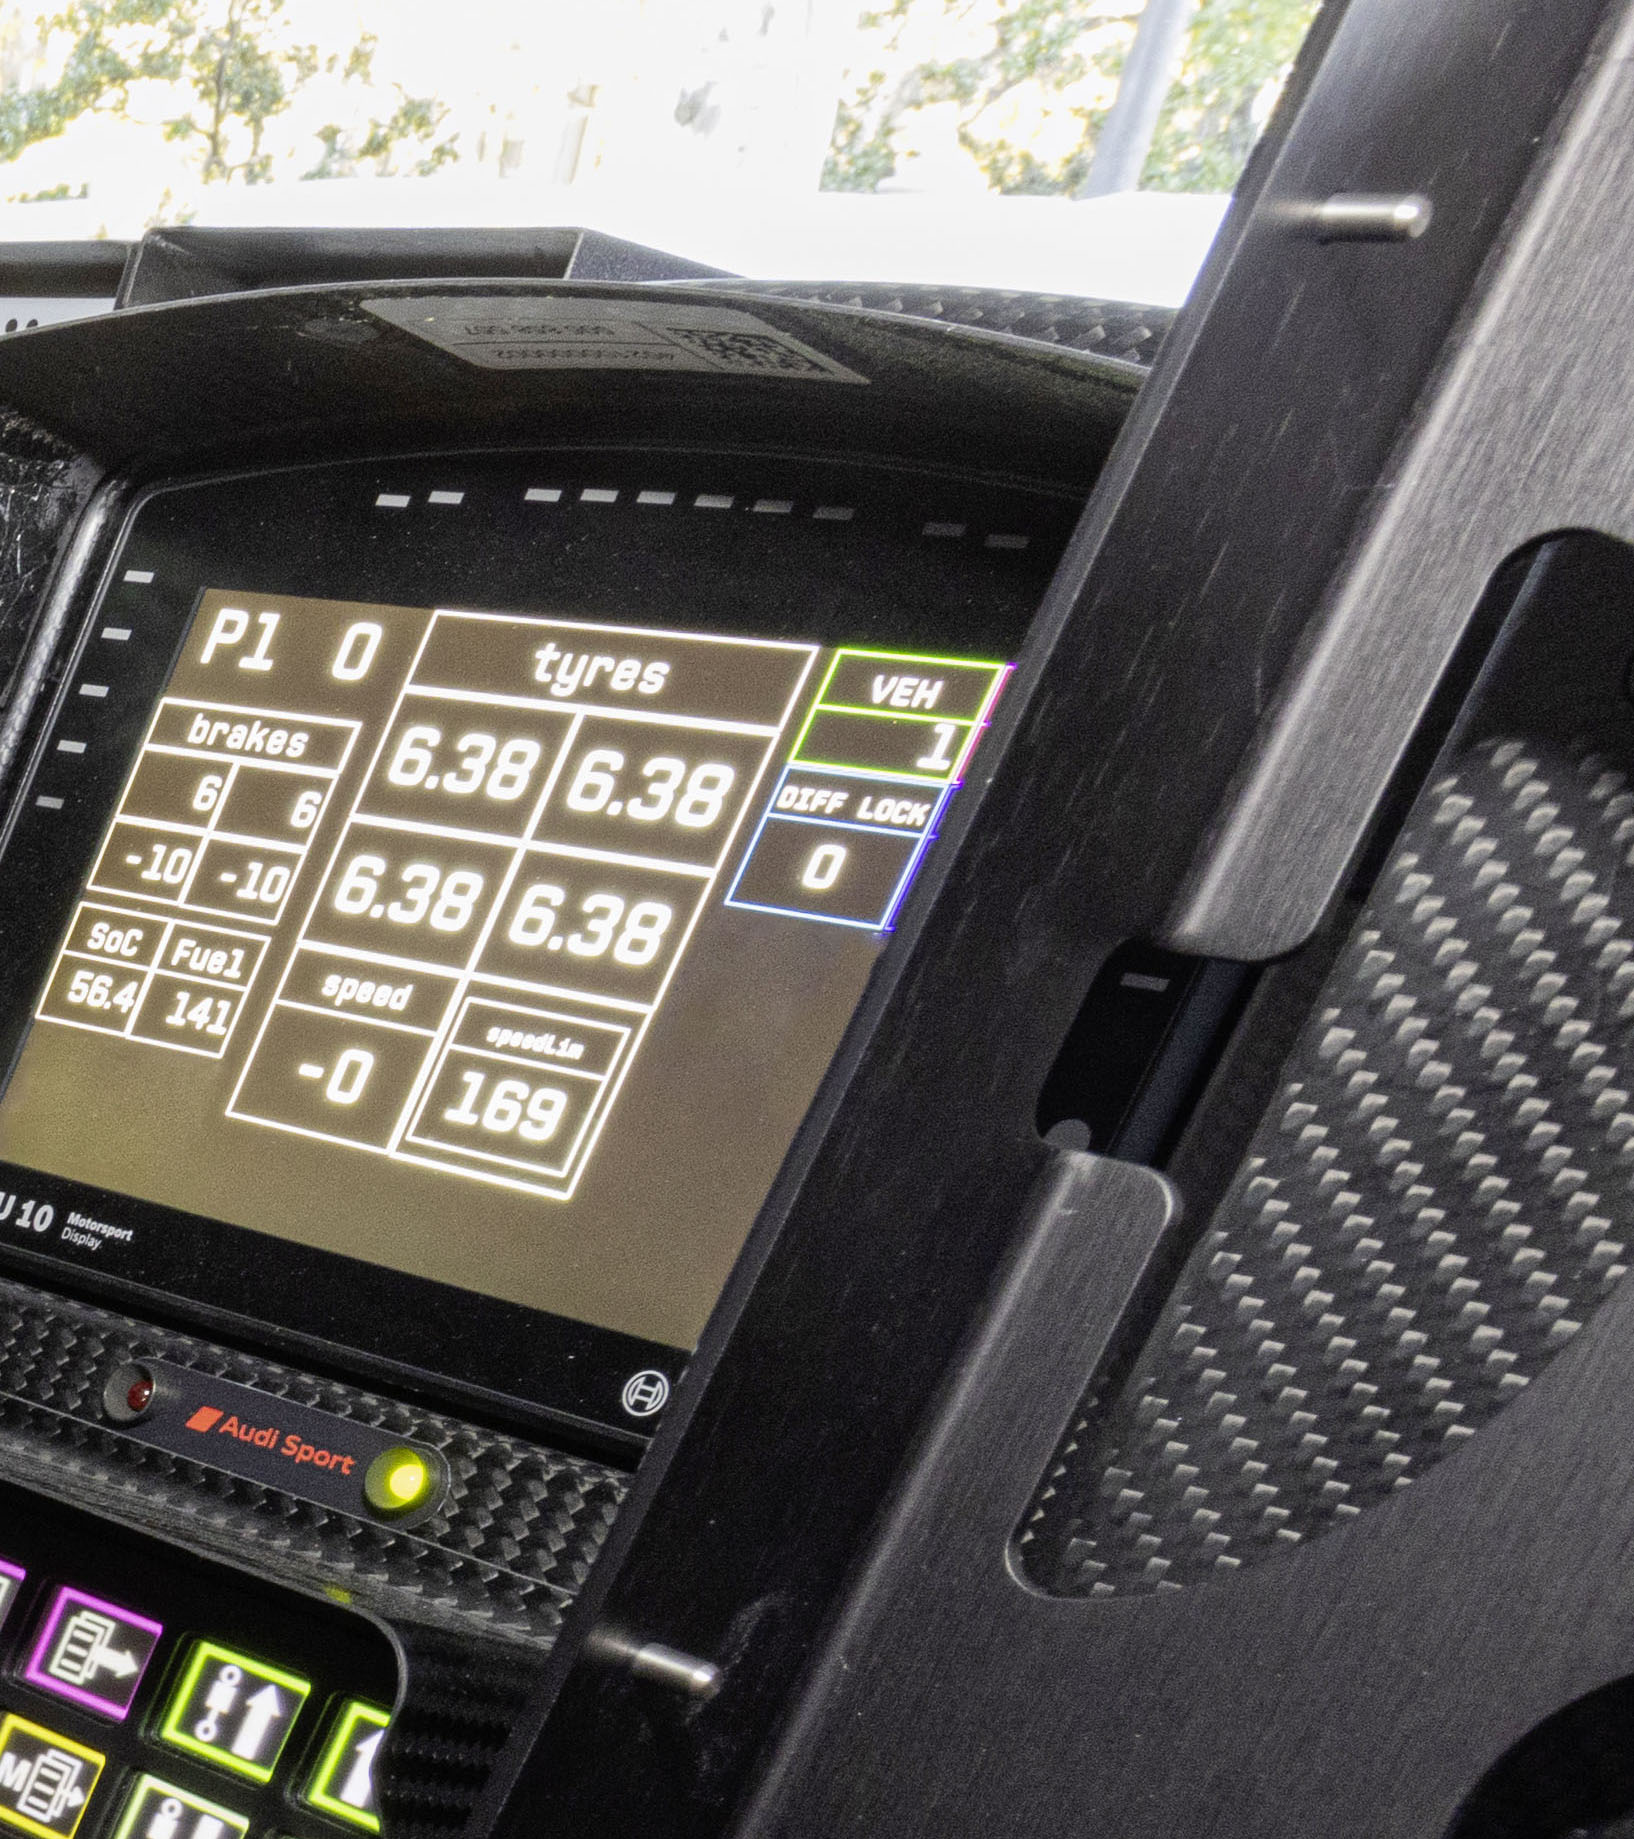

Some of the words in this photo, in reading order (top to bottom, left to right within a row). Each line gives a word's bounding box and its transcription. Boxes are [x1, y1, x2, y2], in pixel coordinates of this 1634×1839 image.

[201, 609, 280, 672] P1
[332, 620, 382, 681] 0
[534, 642, 669, 697] tyres
[871, 674, 943, 710] VEH
[187, 712, 309, 758] brakes
[917, 724, 954, 771] 1
[387, 726, 539, 800] 6.38
[564, 750, 733, 828] 6.38
[191, 773, 219, 812] 6
[291, 790, 320, 830] 6
[777, 787, 848, 818] DIFF
[857, 794, 929, 827] LOCK
[125, 844, 188, 884] -10
[218, 862, 288, 904] -10
[801, 844, 846, 891] 0
[334, 857, 484, 934] 6.38
[505, 888, 673, 968] 6.38
[86, 920, 140, 956] SoC
[172, 939, 244, 979] Fuel
[68, 971, 134, 1015] 56.4
[166, 990, 231, 1037] 141
[322, 969, 413, 1012] speed
[486, 1023, 585, 1061] speedLim
[299, 1048, 374, 1106] -0
[444, 1070, 568, 1143] 169
[17, 1200, 53, 1234] 10
[62, 1227, 100, 1249] Display
[67, 1212, 133, 1242] Motorsport
[217, 1412, 277, 1449] Audi
[284, 1436, 354, 1476] Sport
